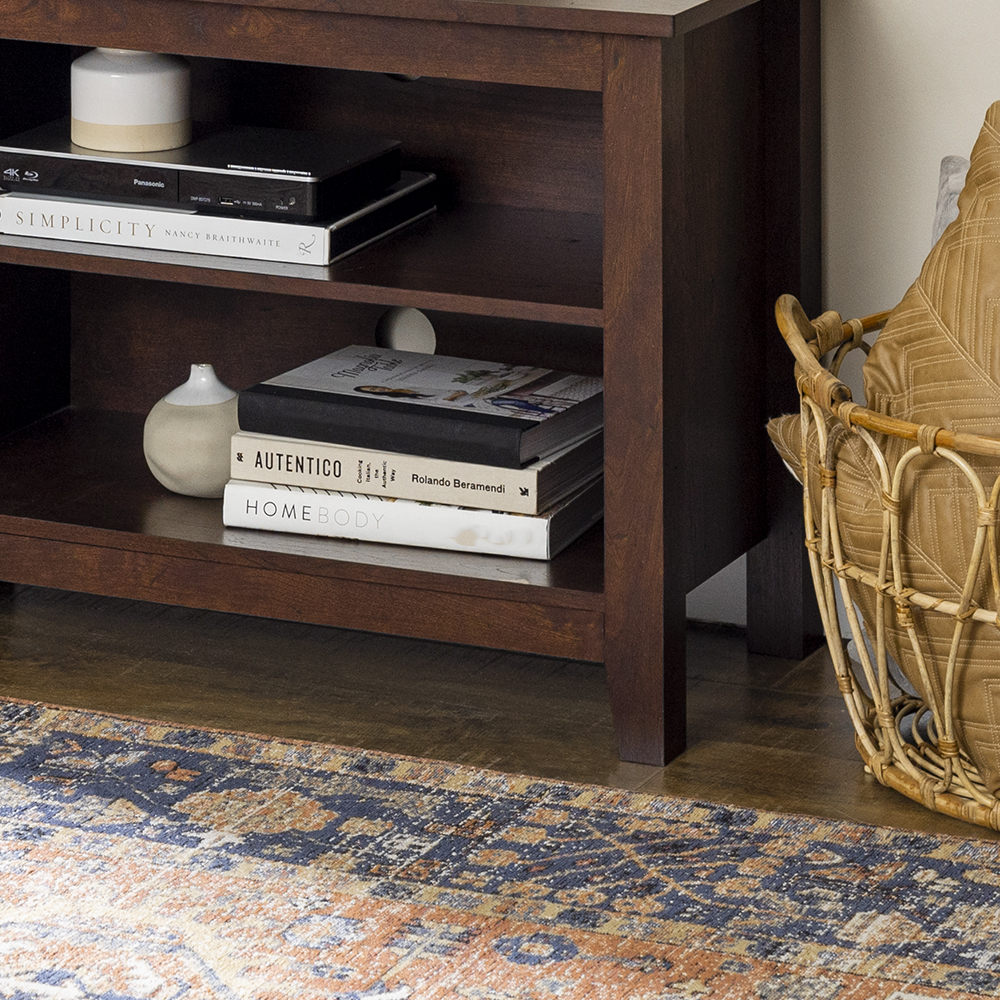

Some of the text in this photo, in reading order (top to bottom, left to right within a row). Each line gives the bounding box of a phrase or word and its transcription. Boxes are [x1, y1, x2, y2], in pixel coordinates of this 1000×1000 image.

[3, 168, 19, 177] 4K
[133, 179, 165, 188] Panasonic
[16, 210, 156, 238] SIMPLICITY
[165, 229, 281, 247] NANCY BRAITHWAITE
[254, 450, 342, 478] AUTENTICO
[411, 473, 506, 494] Rolando Beramendi
[246, 499, 384, 529] HOMEBODY
